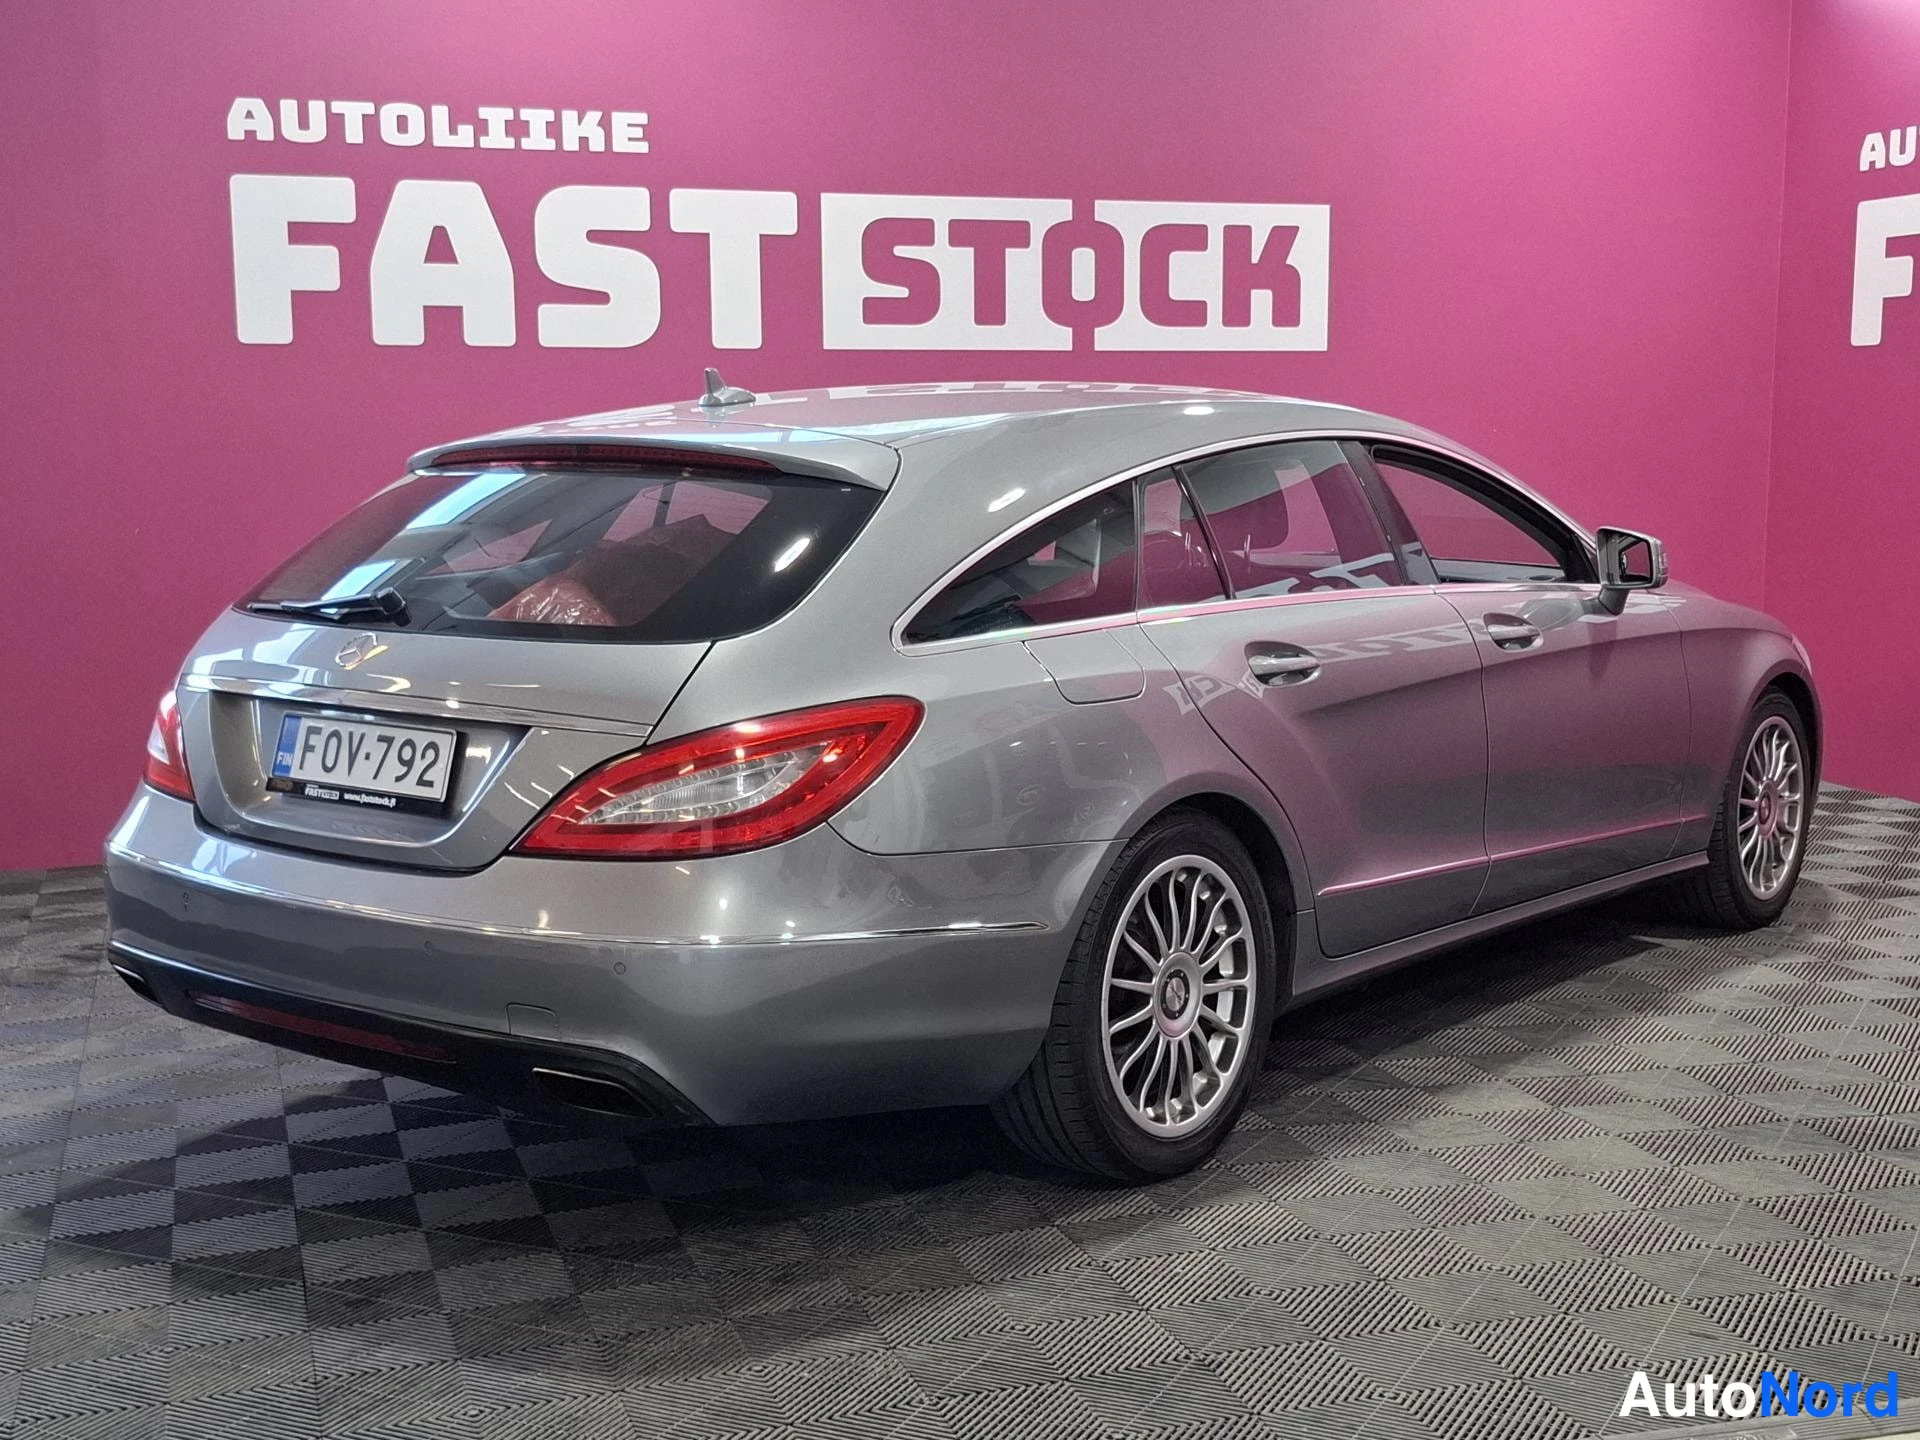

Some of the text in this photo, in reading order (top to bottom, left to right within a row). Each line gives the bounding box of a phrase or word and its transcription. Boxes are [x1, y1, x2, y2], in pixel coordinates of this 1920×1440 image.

[227, 97, 650, 153] AUTOLIIKE
[1859, 125, 1920, 172] AU
[276, 751, 293, 766] FIN
[299, 725, 440, 788] FOV-792
